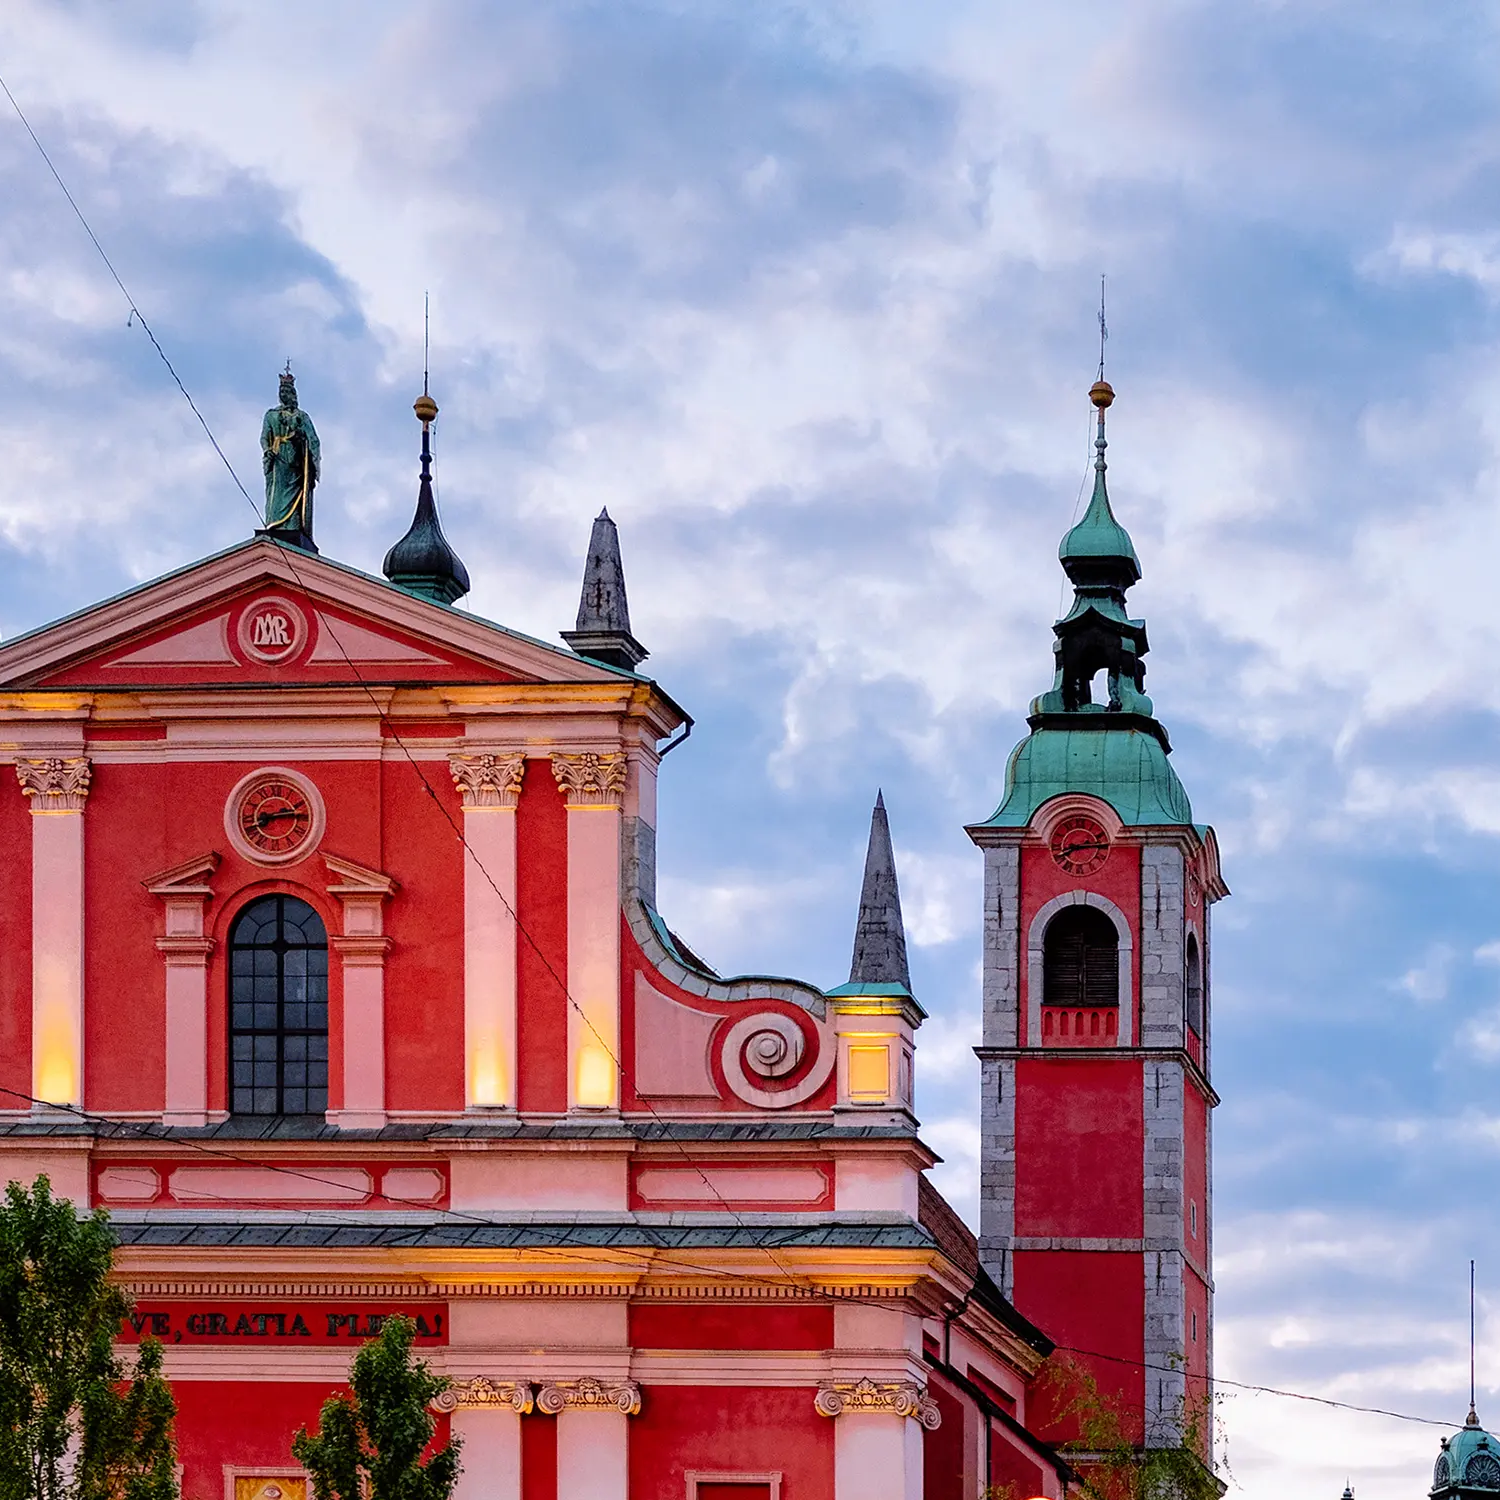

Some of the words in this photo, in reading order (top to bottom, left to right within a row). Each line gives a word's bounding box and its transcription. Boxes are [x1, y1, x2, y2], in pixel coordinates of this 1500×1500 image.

[116, 1312, 182, 1343] VE,
[186, 1313, 311, 1336] GRATIA
[326, 1314, 443, 1337] PLEA!
